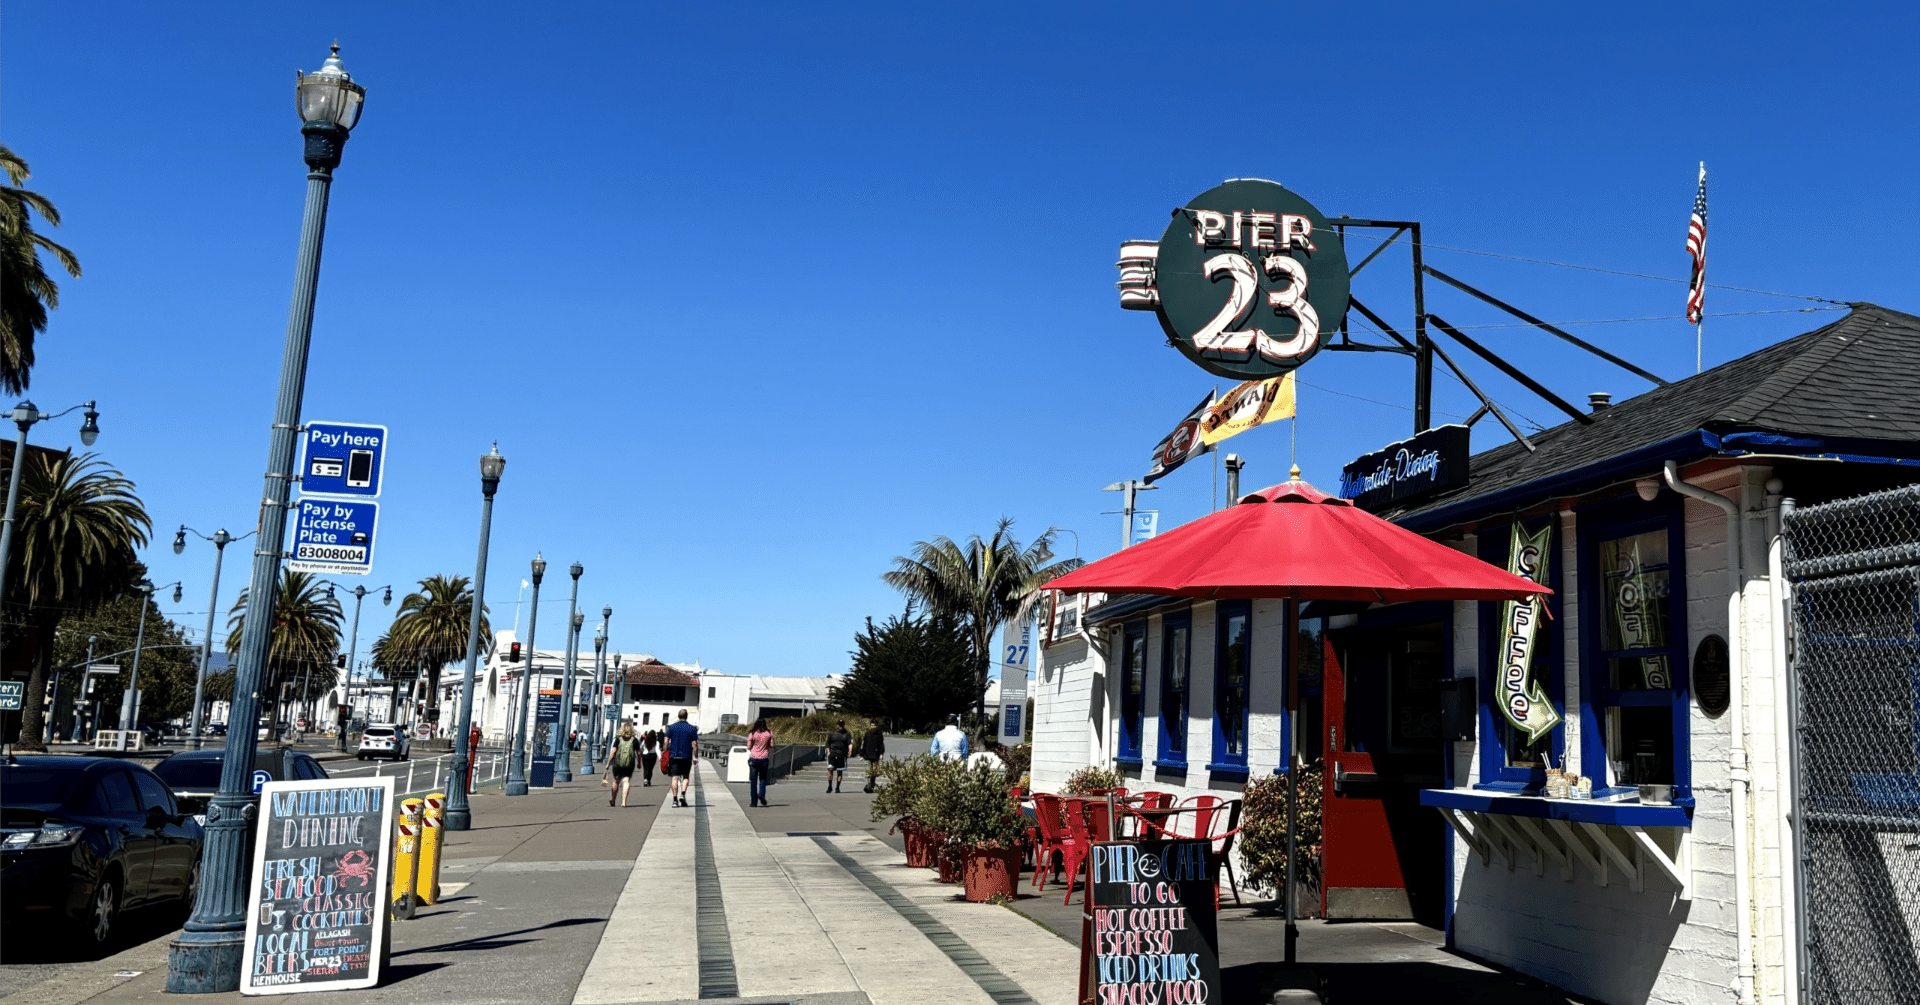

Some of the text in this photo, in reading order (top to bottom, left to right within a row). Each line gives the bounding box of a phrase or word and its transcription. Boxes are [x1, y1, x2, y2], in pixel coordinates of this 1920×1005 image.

[1196, 210, 1317, 251] PIER
[1192, 253, 1319, 359] 23
[311, 430, 379, 447] Pay here
[1395, 448, 1441, 481] Dining
[303, 503, 354, 520] Pay by
[302, 516, 356, 531] License
[300, 530, 337, 543] Plate
[299, 547, 364, 560] 83008004
[1006, 645, 1029, 664] 27
[254, 774, 266, 790] P
[272, 787, 383, 818] WATERFRONT
[282, 815, 364, 849] DINING
[264, 857, 322, 880] FRESH
[1093, 843, 1211, 884] PIER 23 CAFE
[263, 875, 338, 901] SEAFOOD
[1127, 881, 1181, 904] TO GO
[303, 891, 375, 913] CLASSIC
[292, 909, 373, 931] COCKTAILS
[1095, 907, 1188, 932] HOT COFFEE
[256, 931, 313, 956] LOCAL
[314, 928, 351, 940] ALLAGASH
[1095, 929, 1173, 956] ESPRESSO
[310, 955, 342, 968] PIER 23
[313, 944, 366, 957] FORT POINT
[253, 951, 310, 976] BEERS
[341, 962, 349, 970] &
[1098, 952, 1201, 984] ICED DRINKS
